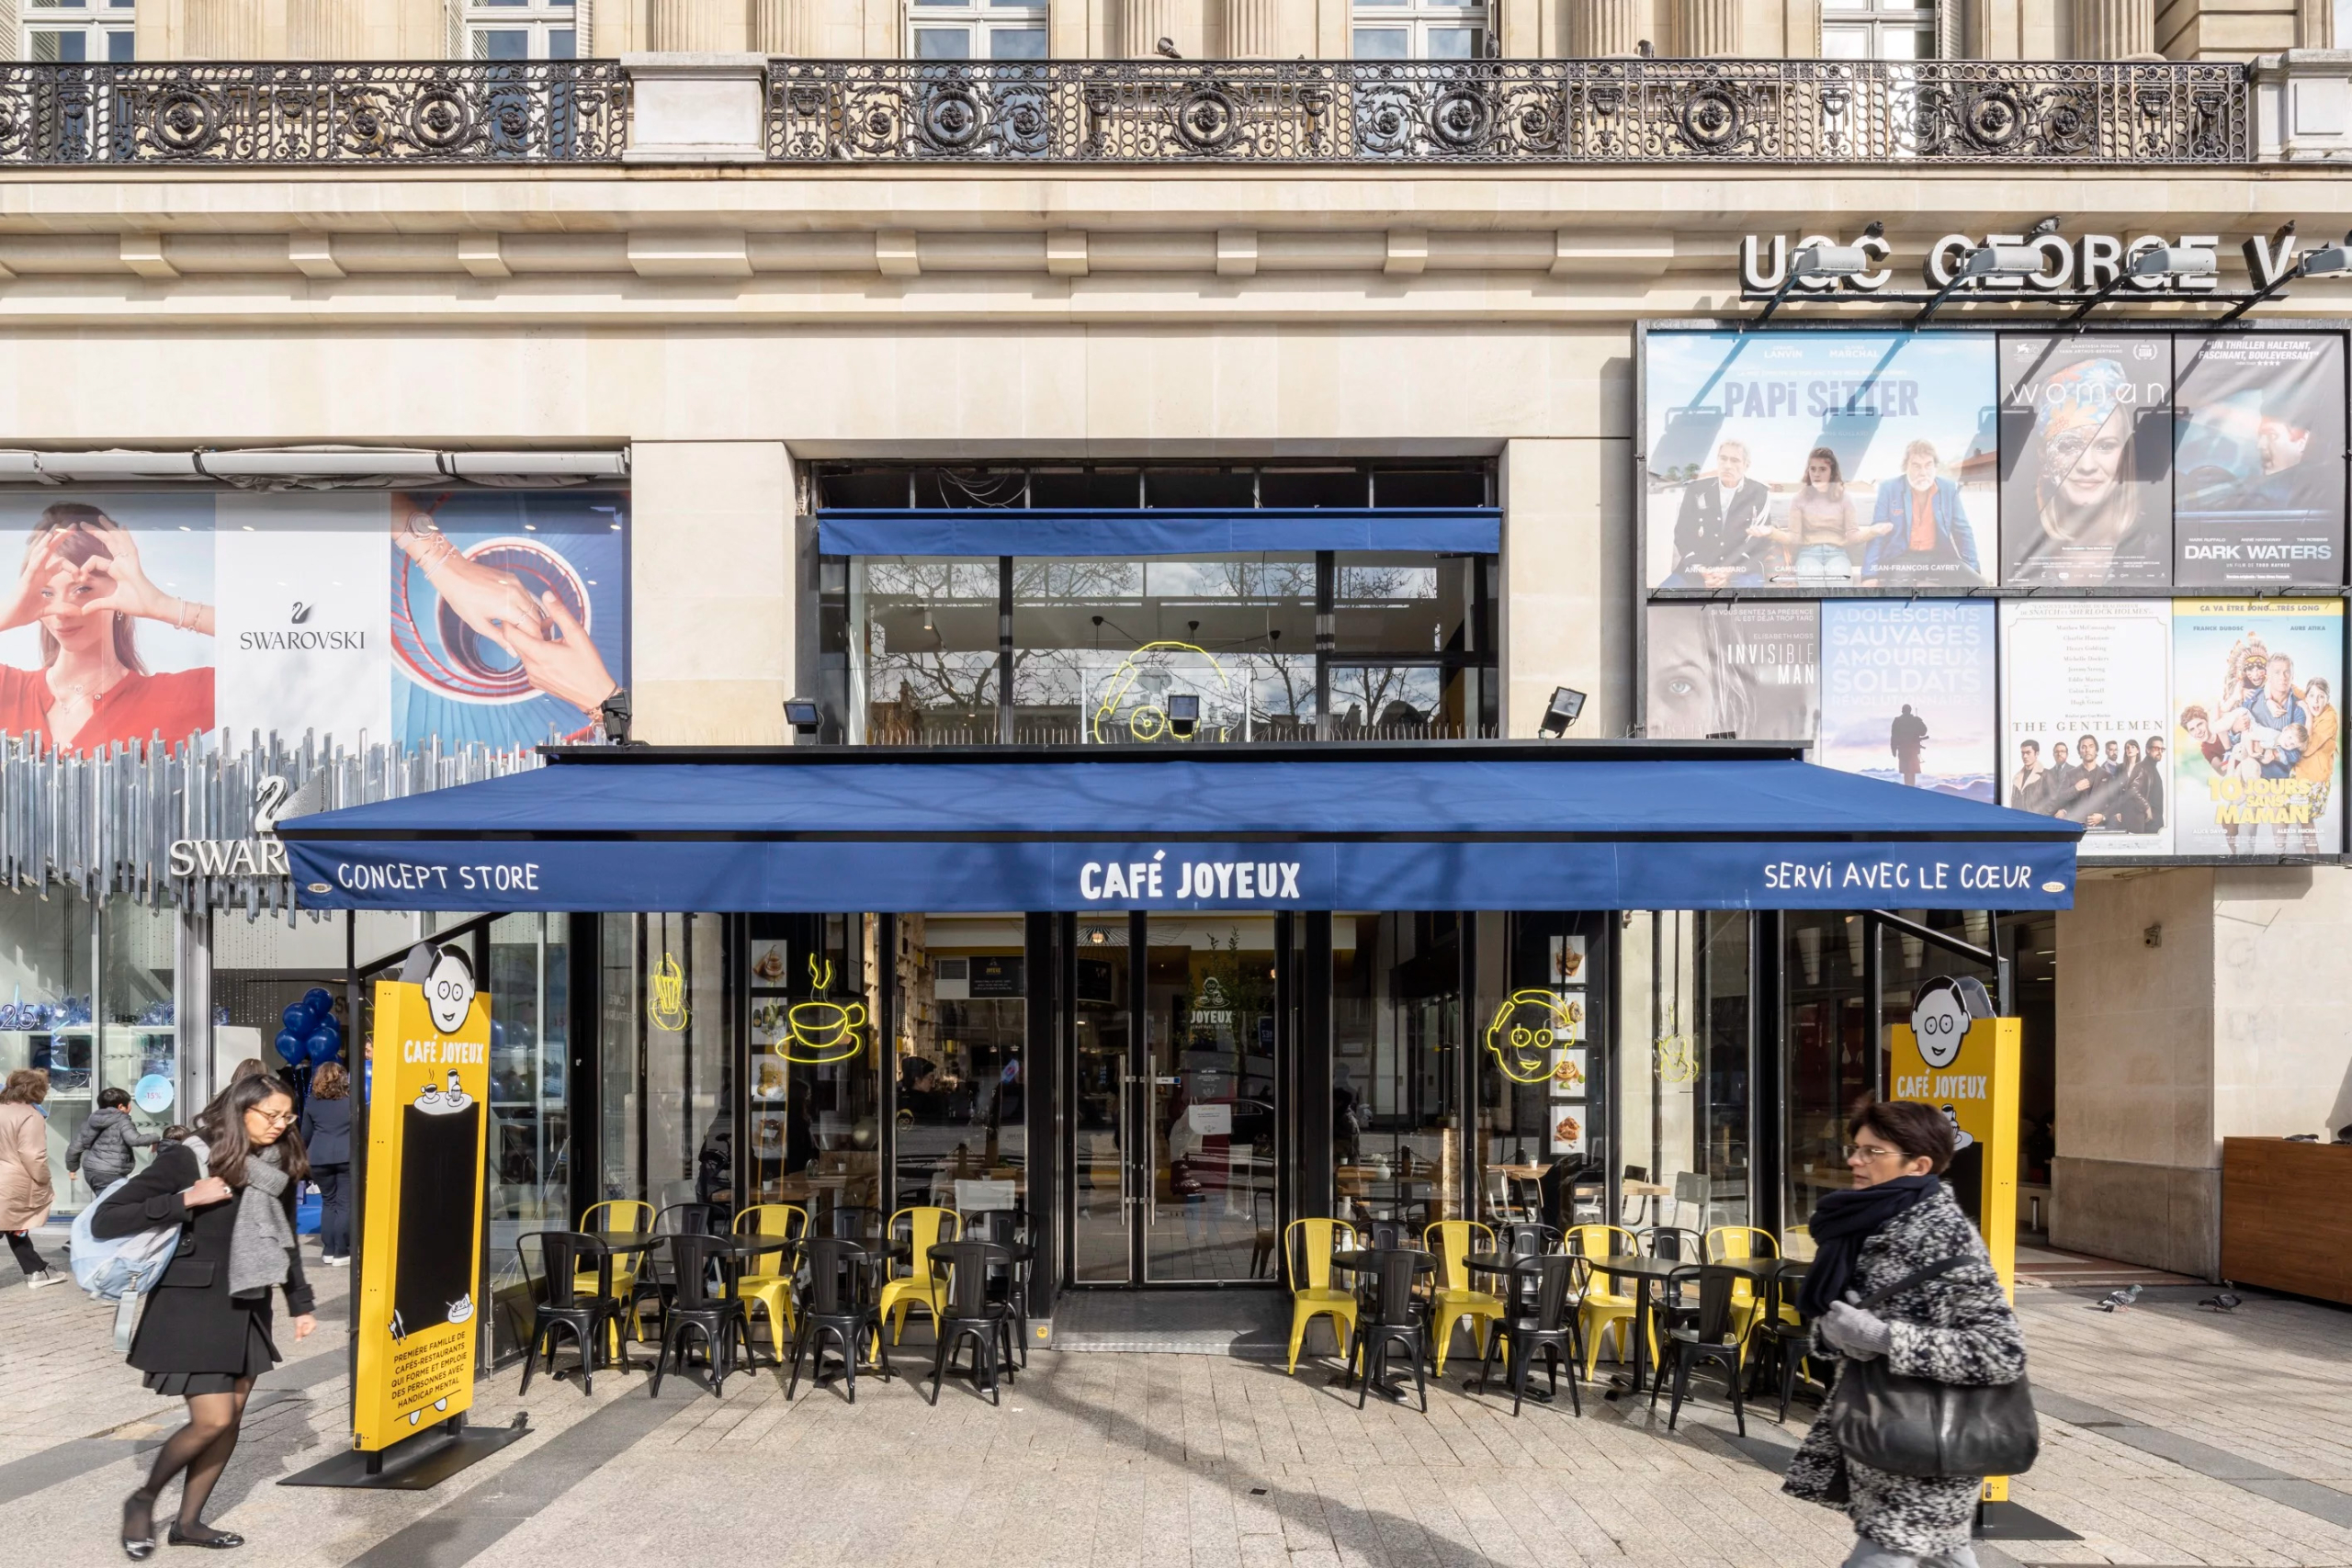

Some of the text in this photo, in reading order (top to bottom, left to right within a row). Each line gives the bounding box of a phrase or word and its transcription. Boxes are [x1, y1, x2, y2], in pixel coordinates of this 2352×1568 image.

[1764, 349, 1803, 359] LANVIN
[1829, 349, 1881, 358] MARCHAL
[2199, 351, 2246, 360] FASCINANT,
[2226, 341, 2265, 350] THRILLER
[2267, 341, 2311, 351] HALETANT,
[2009, 382, 2165, 404] woman
[2185, 545, 2333, 560] DARK WATERS
[1869, 563, 1961, 573] JEAN-FRANÇOIS CAYREY
[1832, 608, 1981, 623] ADOLESCENTS
[2199, 604, 2211, 614] ÇA
[240, 630, 366, 651] SWAROVSKI
[1832, 625, 1981, 647] SAUVAGES
[1727, 643, 1815, 665] INVISIBLE
[1832, 648, 1981, 666] AMOUREUX
[1777, 664, 1815, 684] MAN
[1832, 668, 1981, 694] SOLDATS
[2012, 720, 2164, 732] THE GENTLEMEN
[2208, 777, 2311, 802] 10 JOURS
[2246, 795, 2285, 807] SANS
[2215, 805, 2309, 824] MAMAN
[169, 839, 291, 877] SWAR
[337, 862, 539, 891] CONCEPT STORE
[1080, 849, 1301, 900] CAFÉ JOYEUX
[1843, 861, 1910, 889] AVEC
[1919, 862, 1950, 889] LE
[1960, 863, 2031, 889] CŒUR
[1190, 1010, 1233, 1023] JOYEUX
[403, 1033, 484, 1065] CAFÉ JOYEUX
[1896, 1068, 1987, 1100] CAFÉ JOYEUX
[393, 1330, 466, 1364] PREMIÈRE FAMILLE DE
[394, 1342, 466, 1375] CAFÉS-RESTAURANTS
[390, 1351, 468, 1389] QUI FORME ET EMPLOIE
[391, 1363, 465, 1400] DES PERSONNES AVEC
[397, 1377, 459, 1409] HANDICAP MENTAL
